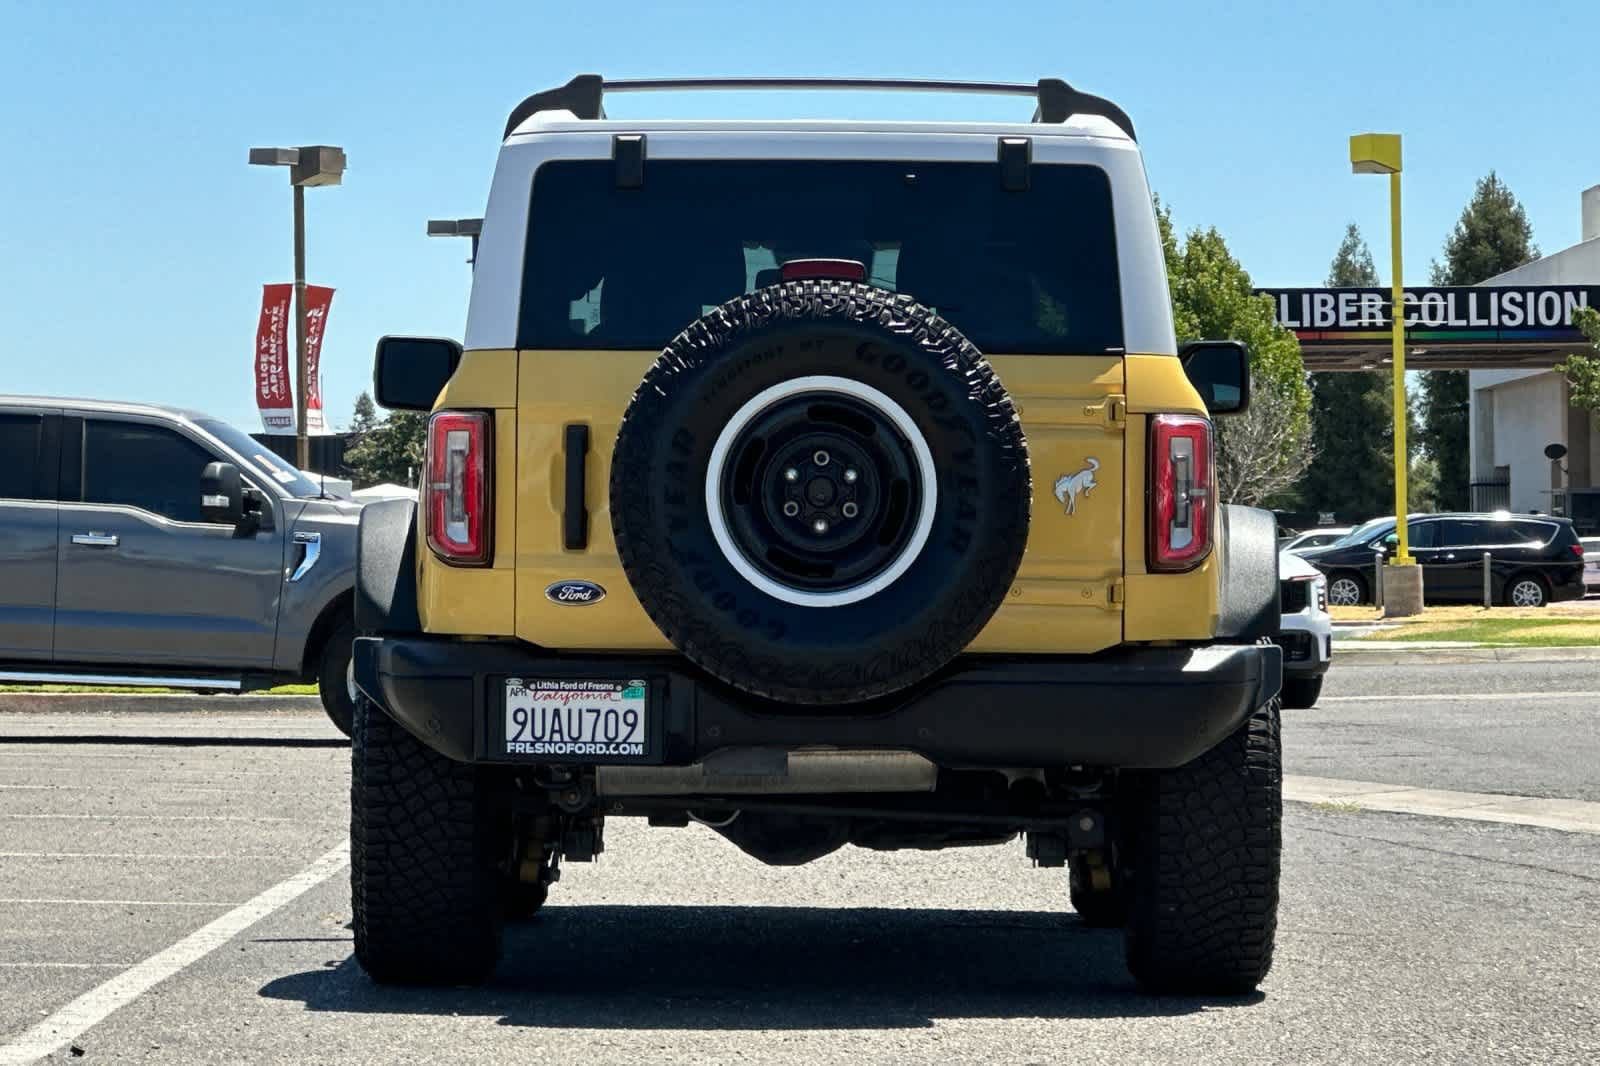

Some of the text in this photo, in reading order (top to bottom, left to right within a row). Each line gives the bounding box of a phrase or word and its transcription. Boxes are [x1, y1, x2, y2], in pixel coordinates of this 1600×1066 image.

[1272, 291, 1588, 327] LIBER COLLISION
[558, 585, 592, 600] Ford
[510, 687, 528, 697] APR
[536, 681, 614, 691] Lithia Ford of Fresno
[532, 690, 614, 706] California
[511, 707, 639, 743] 9UAU709
[506, 742, 643, 755] FRESNOFORD.COM
